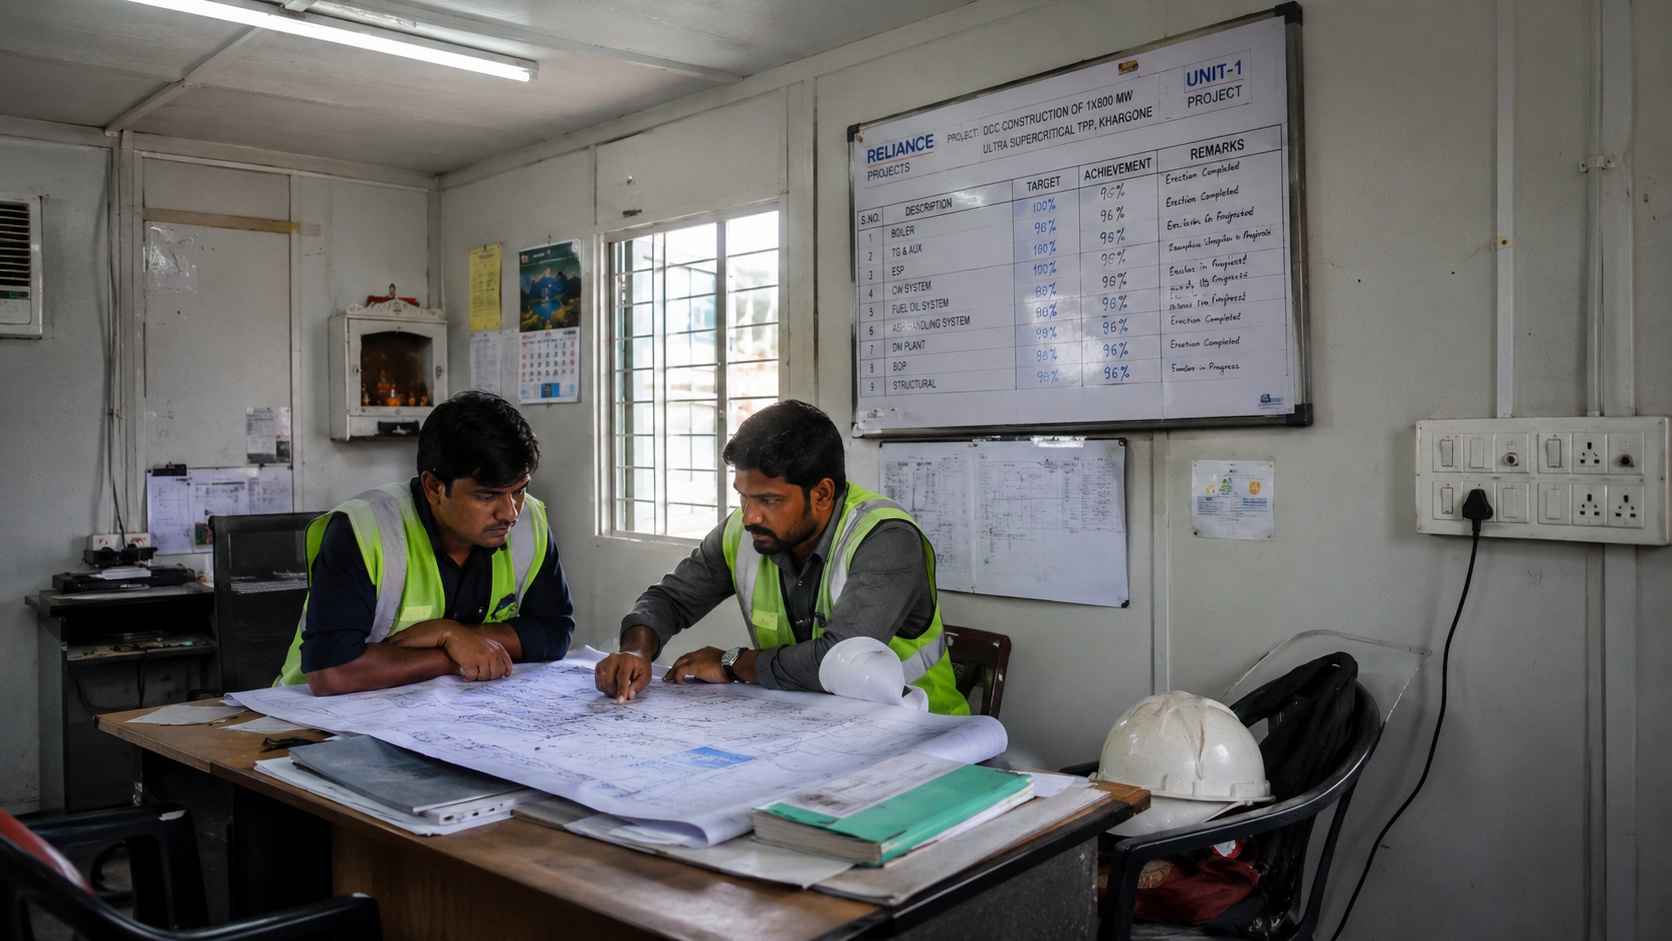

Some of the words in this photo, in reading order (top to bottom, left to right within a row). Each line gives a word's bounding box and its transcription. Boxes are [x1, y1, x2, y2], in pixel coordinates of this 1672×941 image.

[1186, 59, 1242, 87] UNIT-1
[1187, 84, 1243, 108] PROJECT
[1001, 105, 1069, 131] CONSTRUCTION
[1071, 101, 1083, 115] OF
[1087, 94, 1114, 112] 1X800
[1115, 89, 1134, 104] MW
[983, 138, 1009, 154] ULTRA
[1010, 125, 1075, 148] SUPERCRITICAL
[1100, 105, 1153, 129] KHARGONE
[867, 133, 934, 163] RELIANCE
[1190, 138, 1245, 160] REMARKS
[867, 162, 911, 181] PROJECTS
[1084, 157, 1152, 180] ACHIEVEMENT
[1026, 175, 1061, 192] TARGET
[905, 197, 953, 217] DESCRIPTION
[1033, 197, 1056, 214] 100%
[1100, 205, 1125, 222] 96%
[891, 225, 915, 239] BOILER
[892, 265, 905, 277] ESP
[1033, 261, 1056, 277] 100%
[905, 280, 932, 294] SYSTEM
[892, 303, 908, 315] FUEL
[922, 297, 950, 311] SYSTEM
[942, 315, 970, 328] SYSTEM
[904, 339, 926, 352] PLANT
[1103, 341, 1128, 359] 96%
[1104, 365, 1130, 382] 96%
[892, 379, 937, 391] STRUCTURAL
